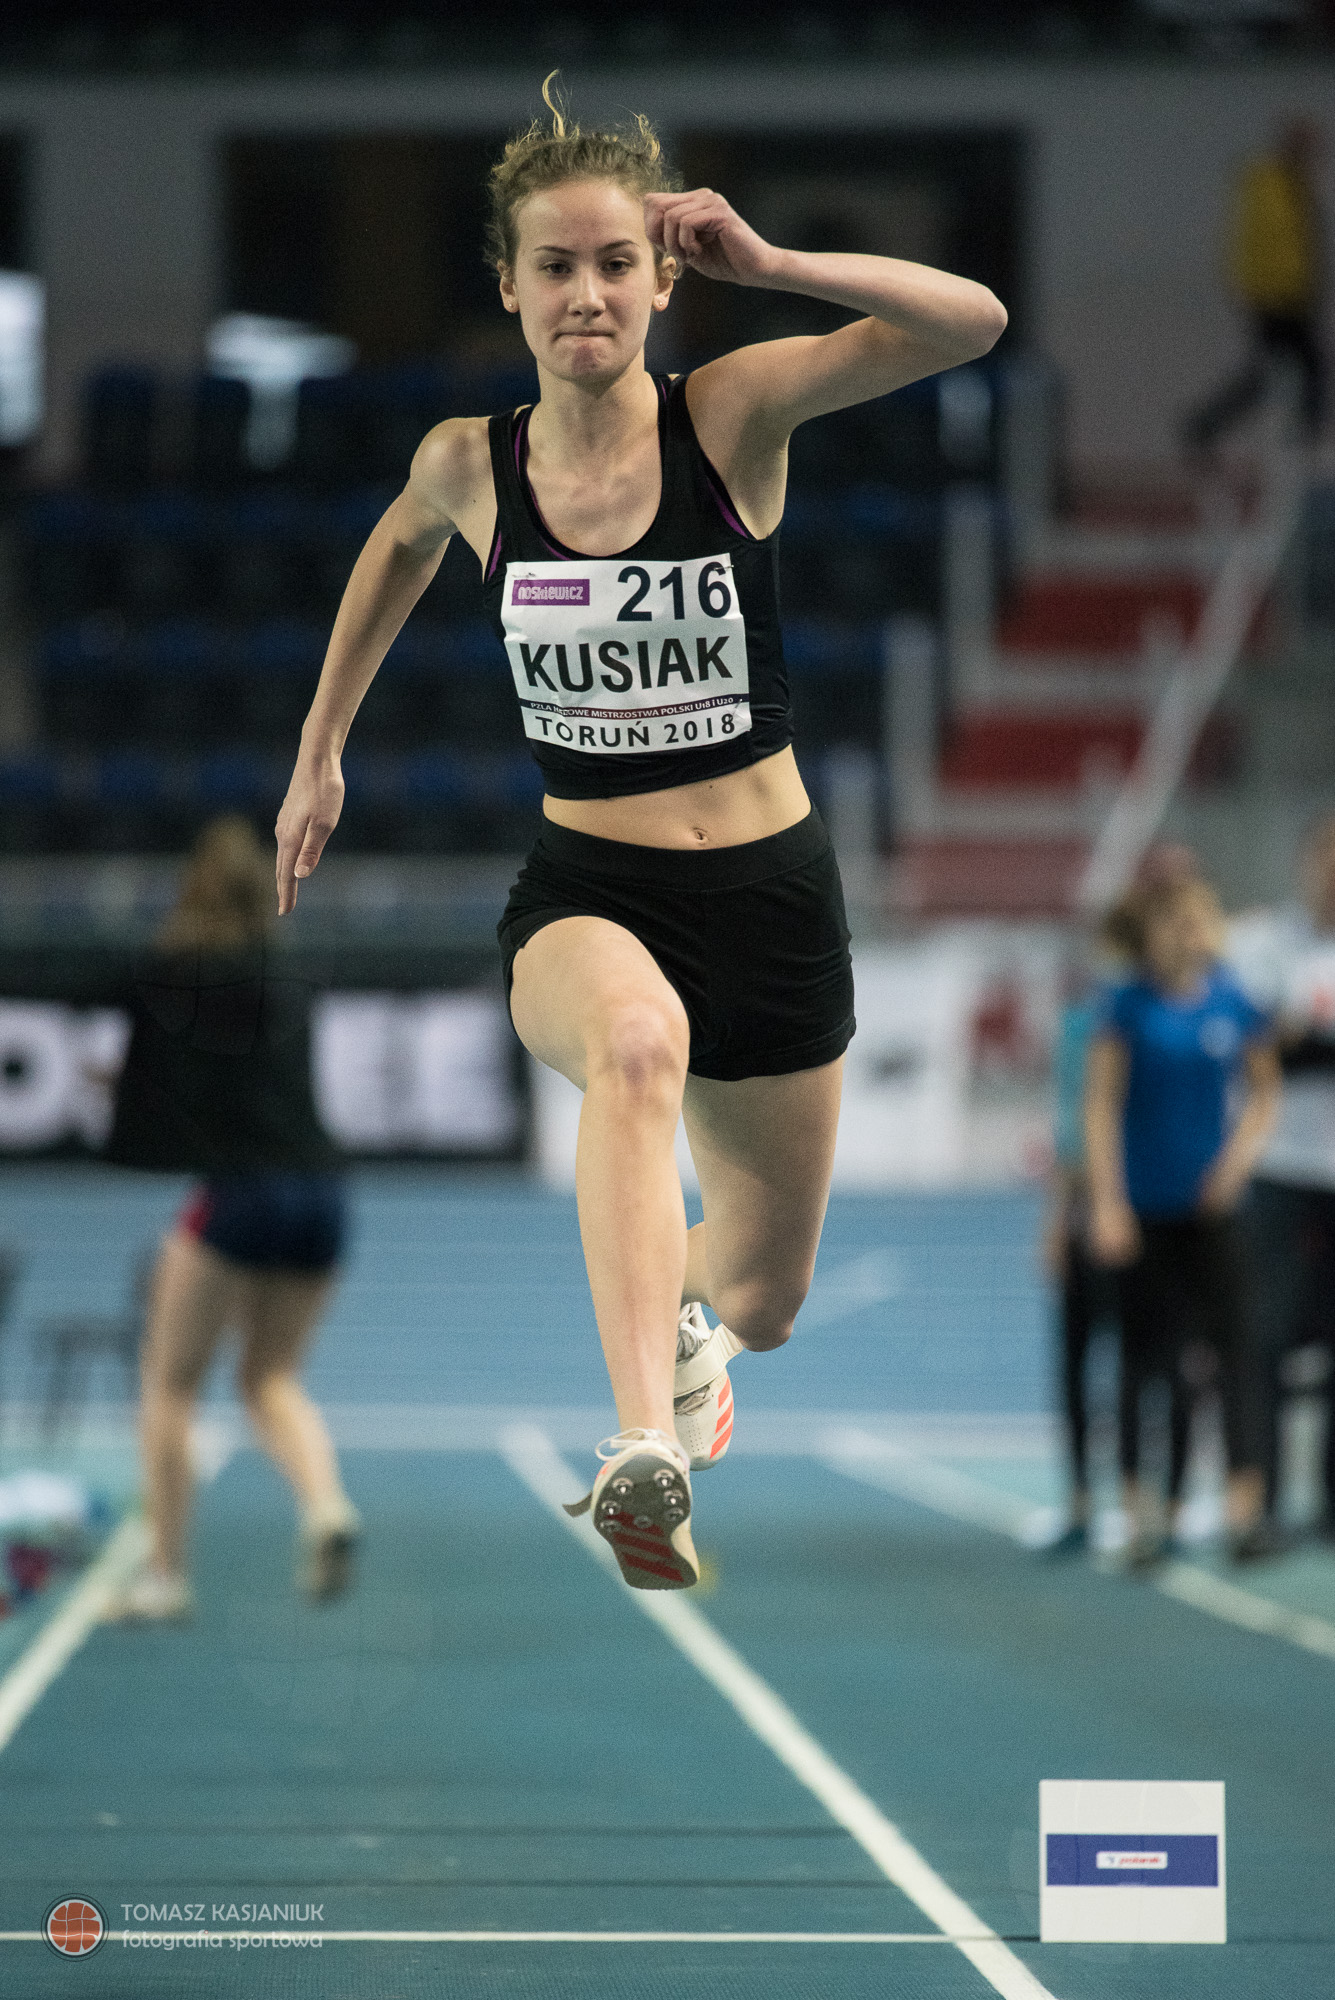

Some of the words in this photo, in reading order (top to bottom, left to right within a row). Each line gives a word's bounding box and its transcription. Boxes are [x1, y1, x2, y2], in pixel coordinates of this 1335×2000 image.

[616, 561, 732, 622] 216
[519, 635, 733, 693] KUSIAK
[530, 702, 553, 711] PZLA
[591, 708, 659, 719] MISTRZOSTWA
[661, 704, 693, 716] POLSKI
[695, 700, 711, 710] U18
[716, 697, 734, 706] U20
[535, 715, 650, 747] TORUŃ
[663, 713, 735, 744] 2018
